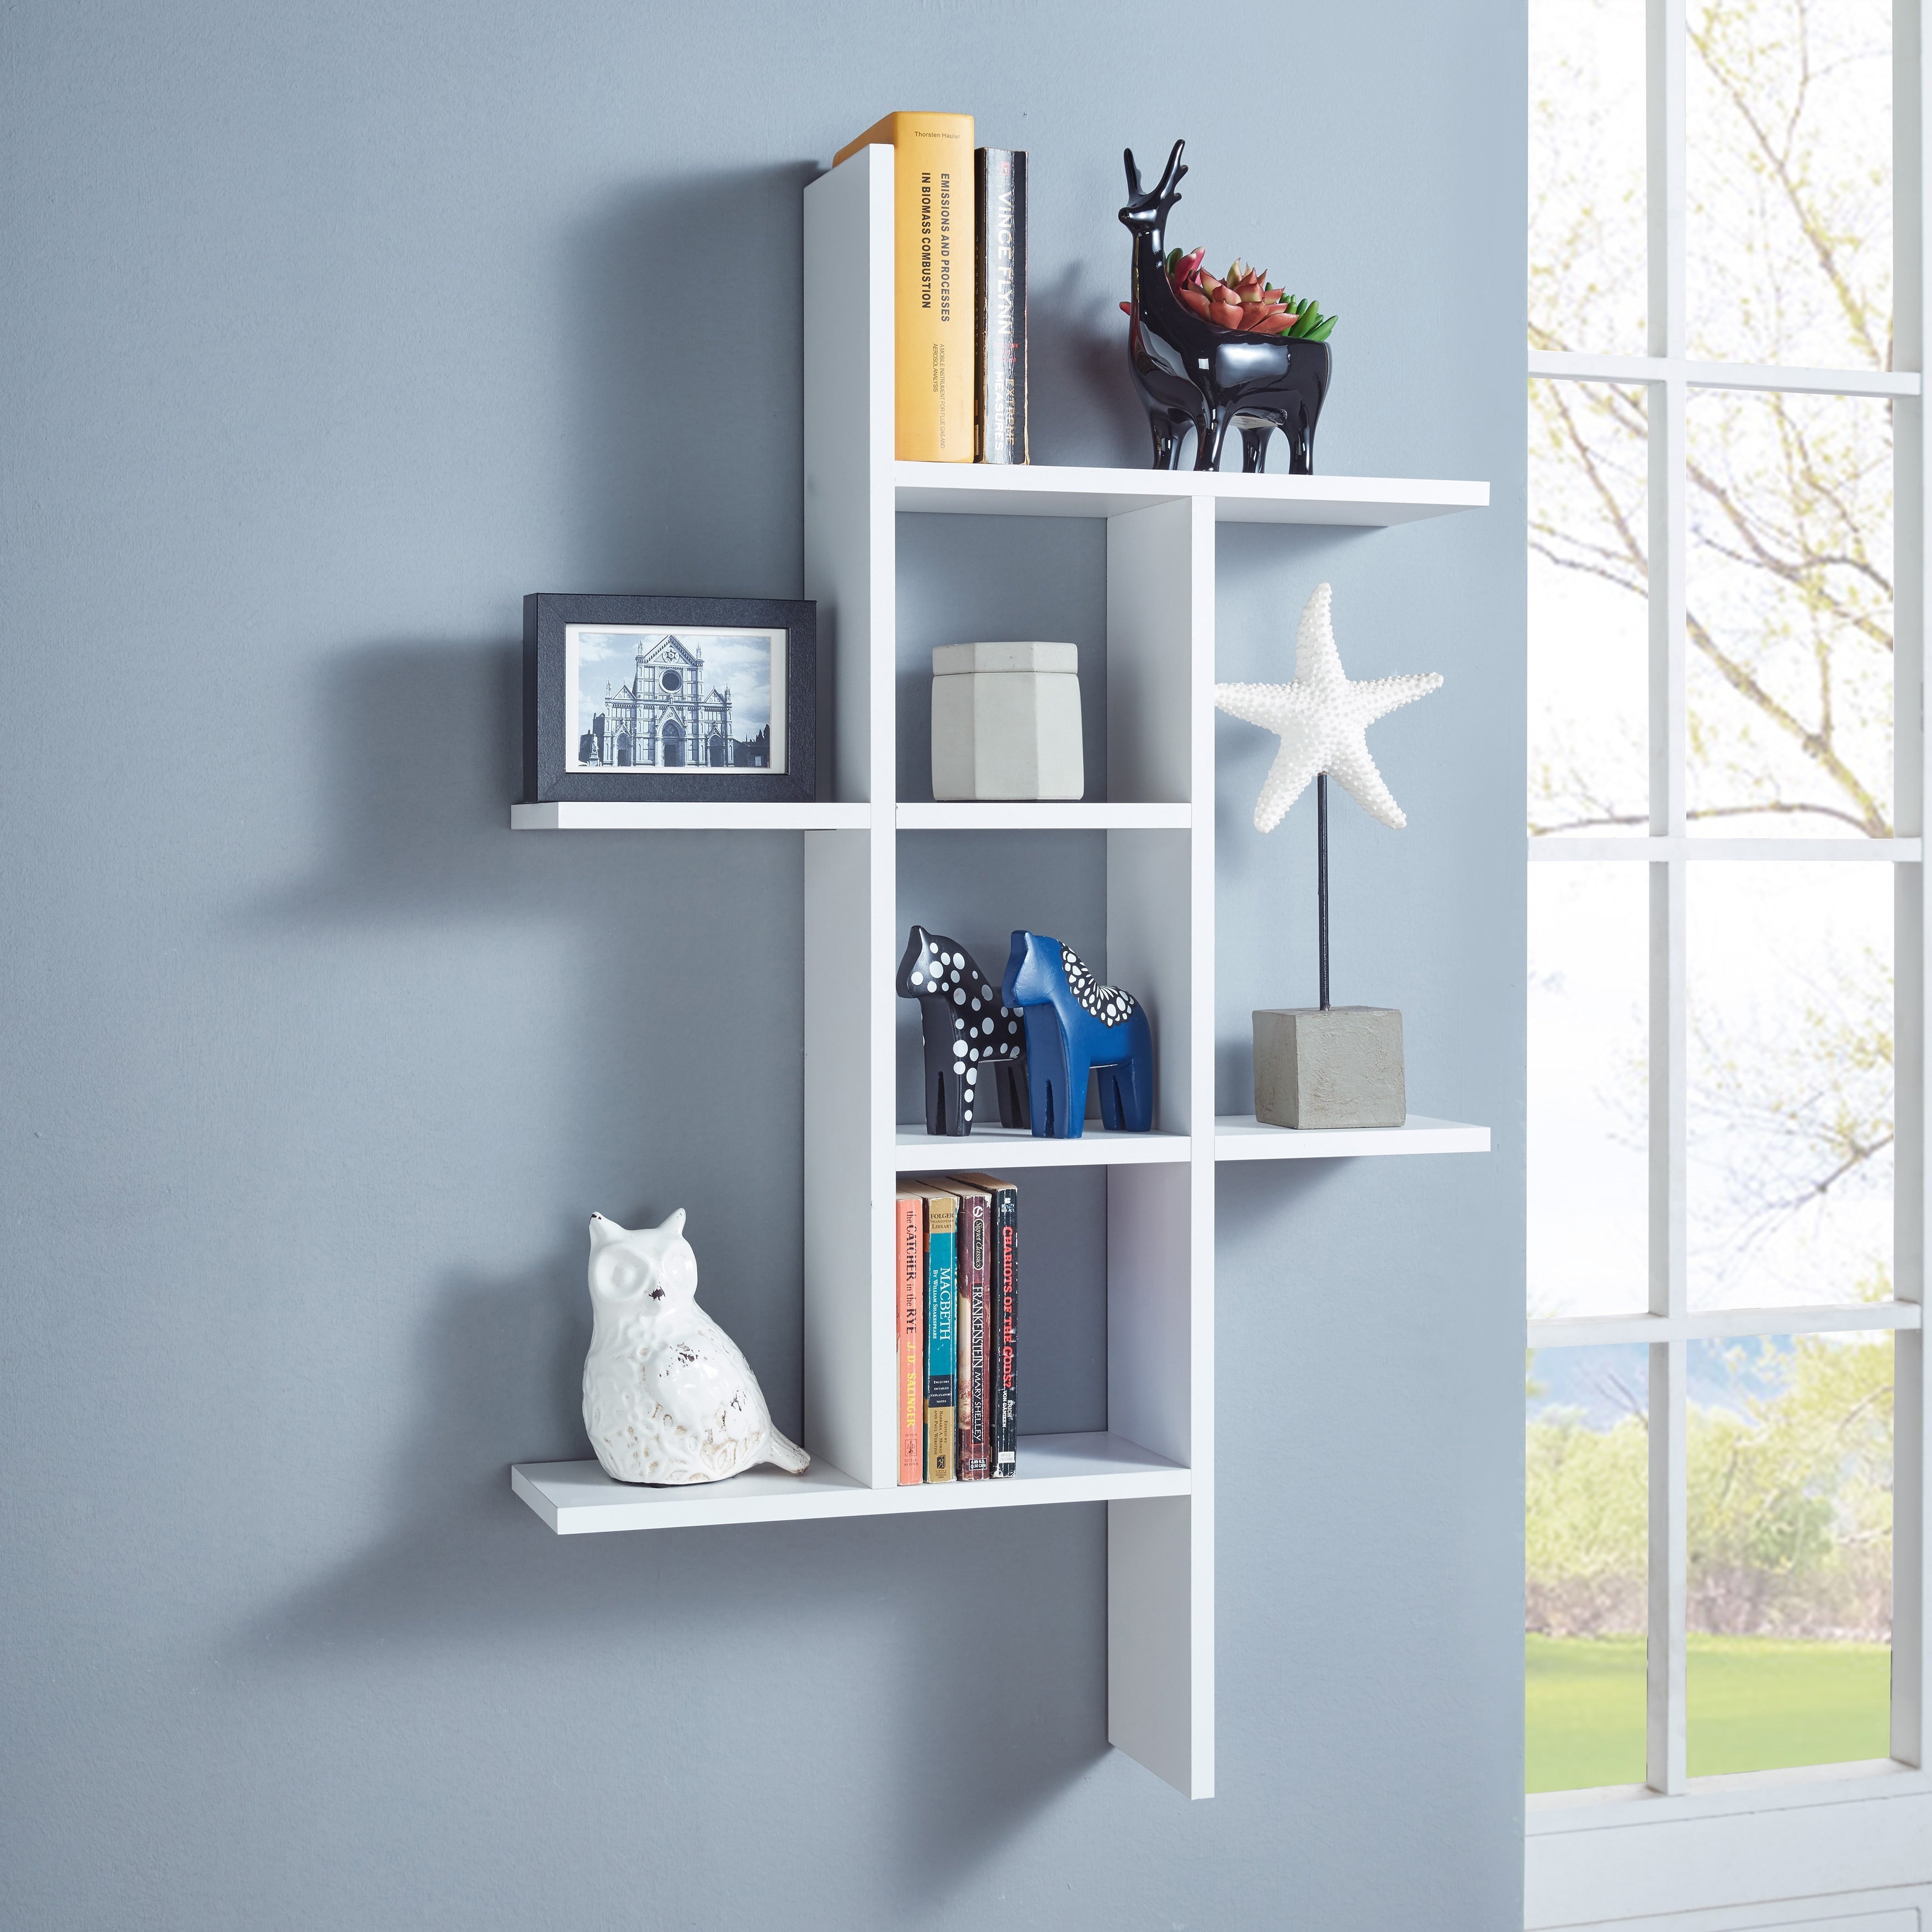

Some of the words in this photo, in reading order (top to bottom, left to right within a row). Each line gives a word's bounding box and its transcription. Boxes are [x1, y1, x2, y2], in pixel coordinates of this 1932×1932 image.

[922, 172, 931, 183] IN
[941, 173, 949, 232] EMISSIONS
[922, 187, 931, 235] BIOMASS
[999, 191, 1012, 259] VINCE
[922, 237, 931, 309] COMBUSTION
[941, 235, 949, 257] AND
[941, 259, 950, 322] PROCESSES
[998, 266, 1012, 335] FLYNN
[995, 371, 1004, 451] MEASURES
[1005, 378, 1015, 445] EXTREME
[906, 1211, 916, 1223] the
[906, 1225, 917, 1281] CATCHER
[1002, 1227, 1013, 1293] CHARIOTS
[906, 1294, 916, 1307] the
[907, 1309, 917, 1334] RYE
[940, 1267, 951, 1340] MACBETH
[972, 1286, 983, 1368] FRANKENSTEIN
[1004, 1296, 1012, 1313] OF
[907, 1341, 915, 1351] J.
[1003, 1316, 1012, 1343] THE
[907, 1356, 916, 1366] D.
[1002, 1346, 1013, 1388] GODS?
[906, 1373, 916, 1427] SALINGER
